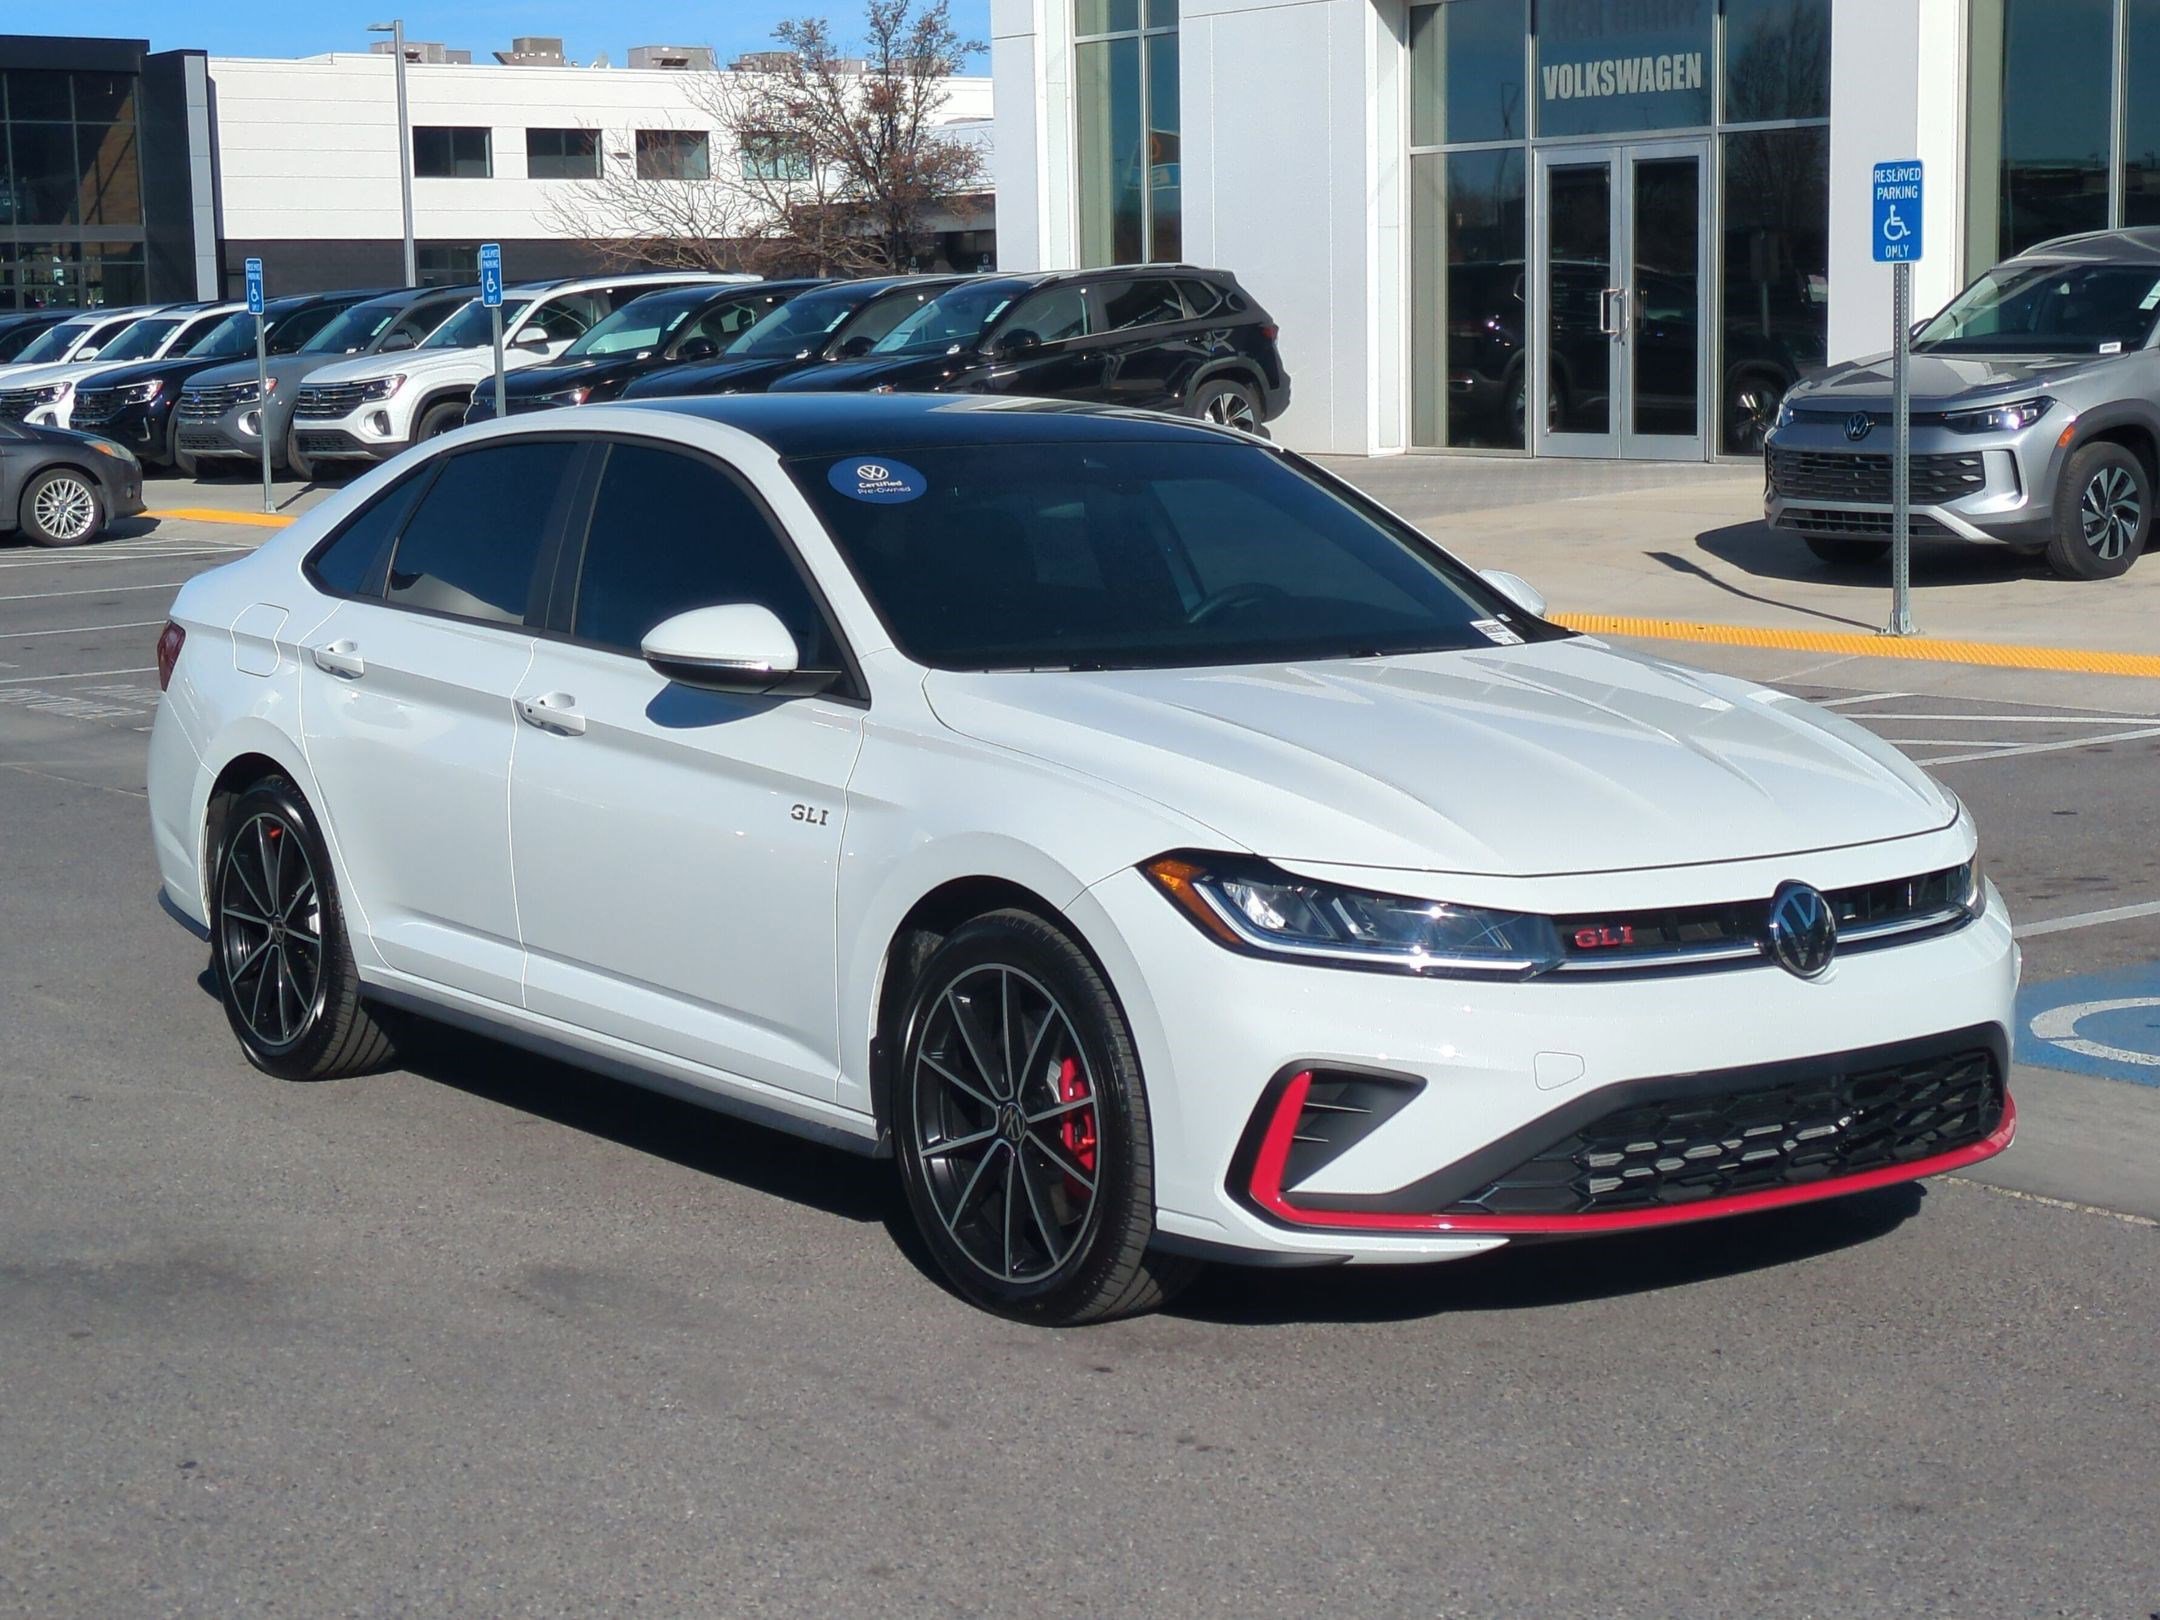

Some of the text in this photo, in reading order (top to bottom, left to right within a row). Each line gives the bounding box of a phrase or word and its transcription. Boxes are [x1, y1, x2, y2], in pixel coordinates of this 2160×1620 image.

[1543, 52, 1701, 100] VOLKSWAGEN
[1875, 168, 1921, 183] RESERVED
[1877, 185, 1917, 200] PARKING
[1885, 244, 1909, 258] ONLY
[857, 486, 911, 494] Pre-Owned
[859, 480, 903, 488] Certified
[791, 804, 829, 826] GLI
[1575, 926, 1632, 948] GLI
